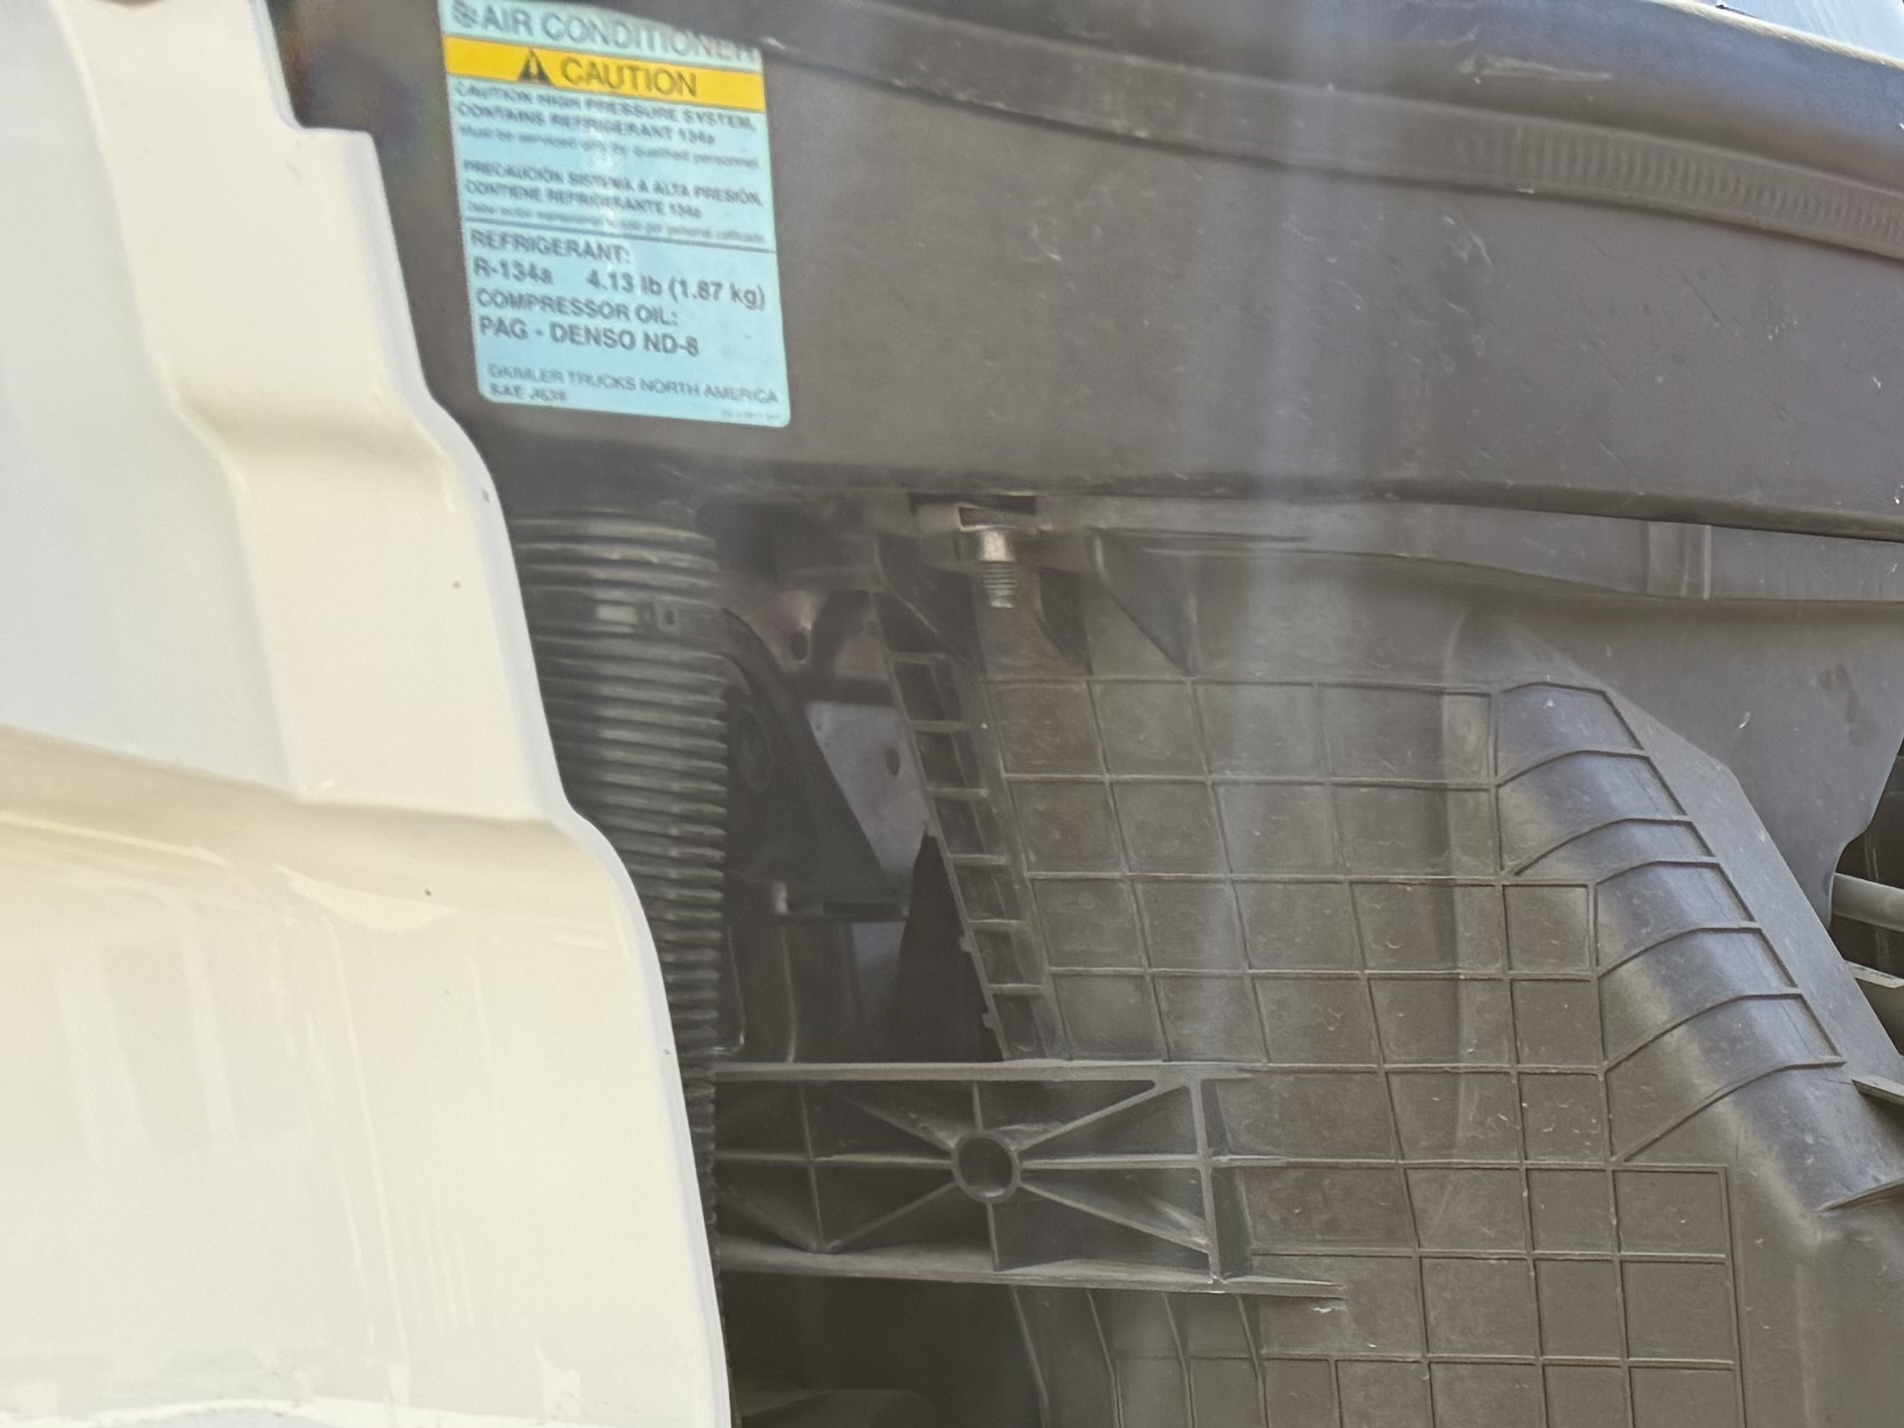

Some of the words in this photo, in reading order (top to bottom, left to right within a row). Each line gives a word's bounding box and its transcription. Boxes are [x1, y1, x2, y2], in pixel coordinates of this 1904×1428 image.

[479, 8, 534, 40] AIR
[560, 57, 698, 97] CAUTION
[458, 104, 545, 127] CONTAINS
[550, 112, 674, 141] REFRIGERANT
[586, 97, 678, 122] PRESSURE
[465, 180, 542, 202] CONTIENE
[546, 188, 664, 215] REFRIGERANTE
[653, 180, 691, 199] ALTA
[470, 230, 631, 265] REFRIGERANT:
[473, 256, 554, 286] R-134a
[586, 271, 635, 295] 4.13
[640, 274, 663, 297] lb
[669, 275, 724, 304] (1.87
[730, 281, 767, 311] kg)
[476, 290, 631, 323] COMPRESSOR
[635, 305, 679, 327] OIL:
[479, 315, 528, 342] PAG
[549, 321, 637, 351] DENSO
[643, 332, 700, 357] ND-8
[487, 363, 566, 388] DAIMLER
[568, 370, 637, 392] TRUCKS
[640, 377, 700, 398] NORTH
[702, 383, 779, 405] AMERICA
[490, 383, 526, 401] SAE
